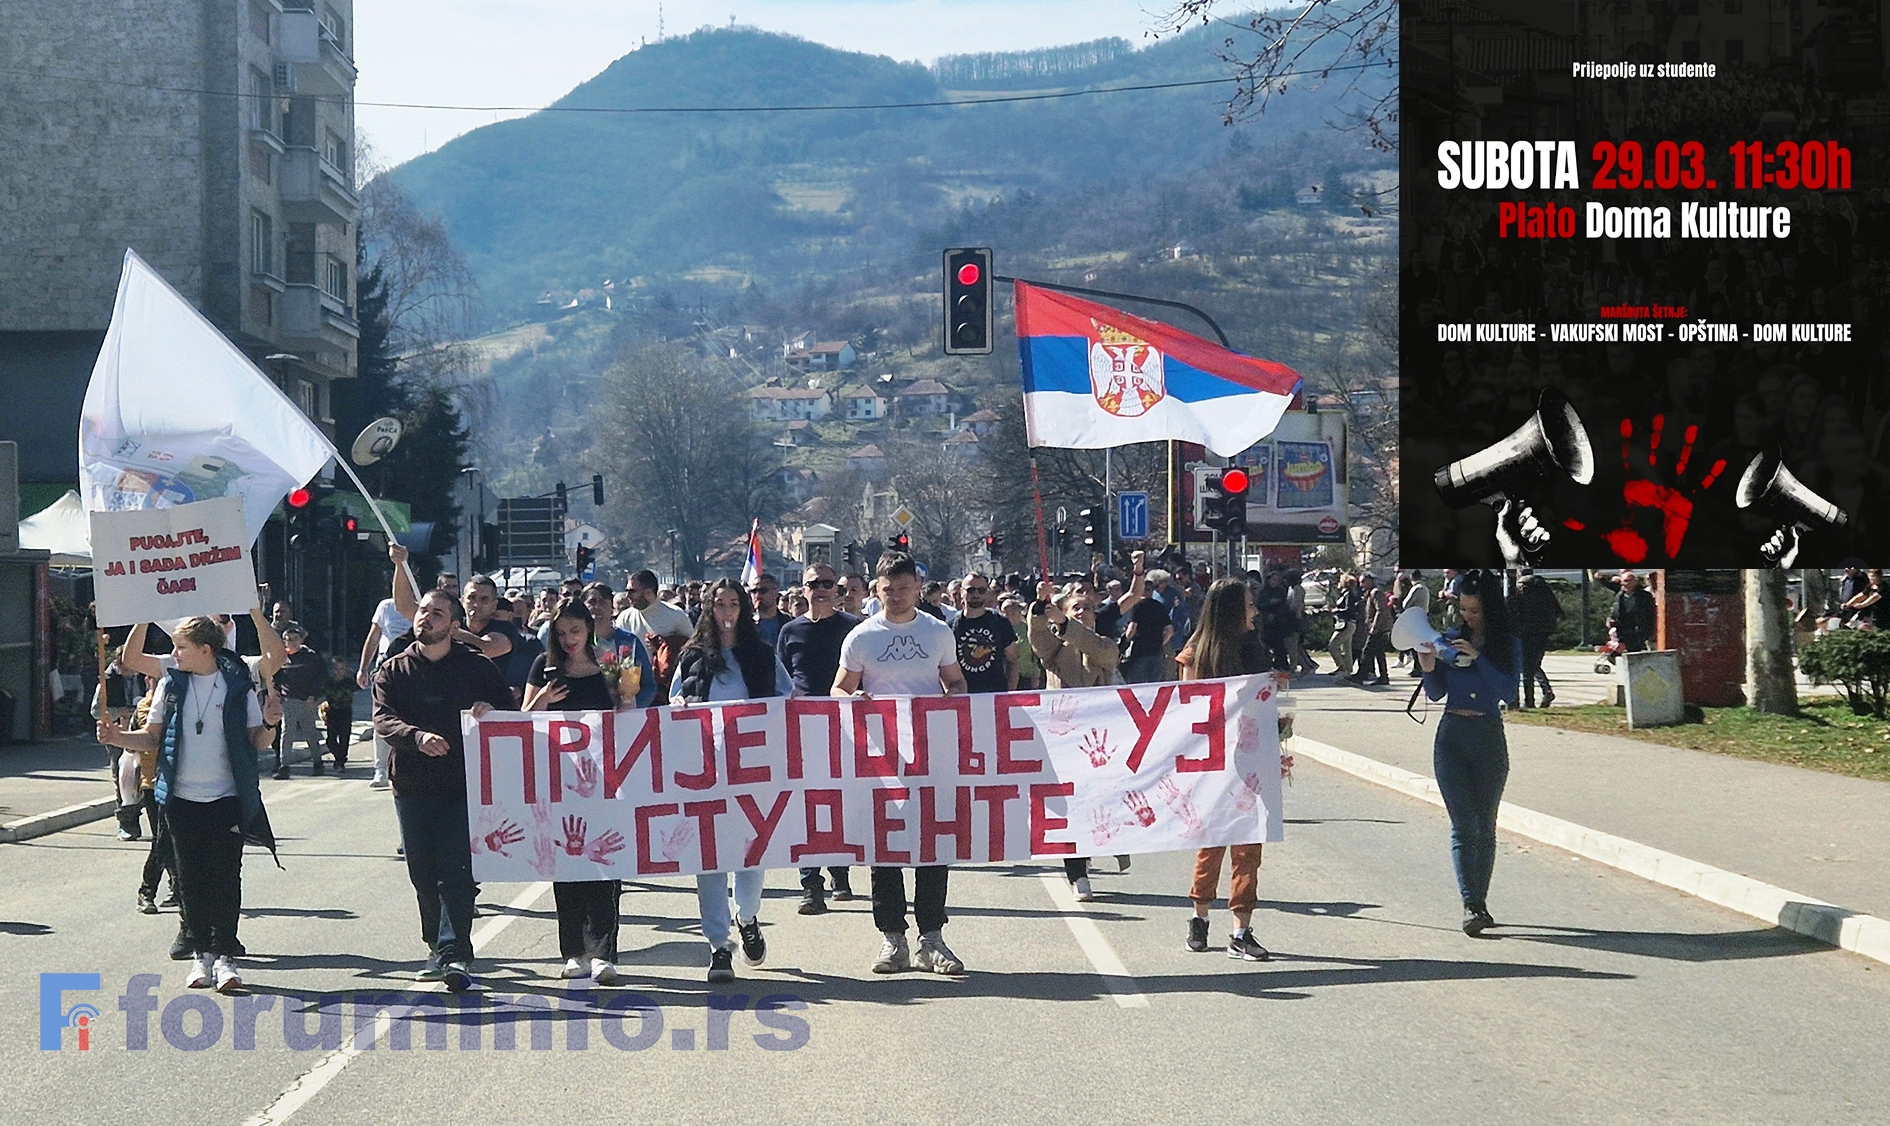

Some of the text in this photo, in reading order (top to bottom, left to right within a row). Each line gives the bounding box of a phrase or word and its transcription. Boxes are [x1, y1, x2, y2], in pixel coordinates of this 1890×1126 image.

[104, 546, 242, 576] JA I SADA DRŽIM
[479, 682, 1226, 805] ПРИЈЕПОЉЕ УЗ
[634, 781, 1077, 875] СТУДЕНТЕ
